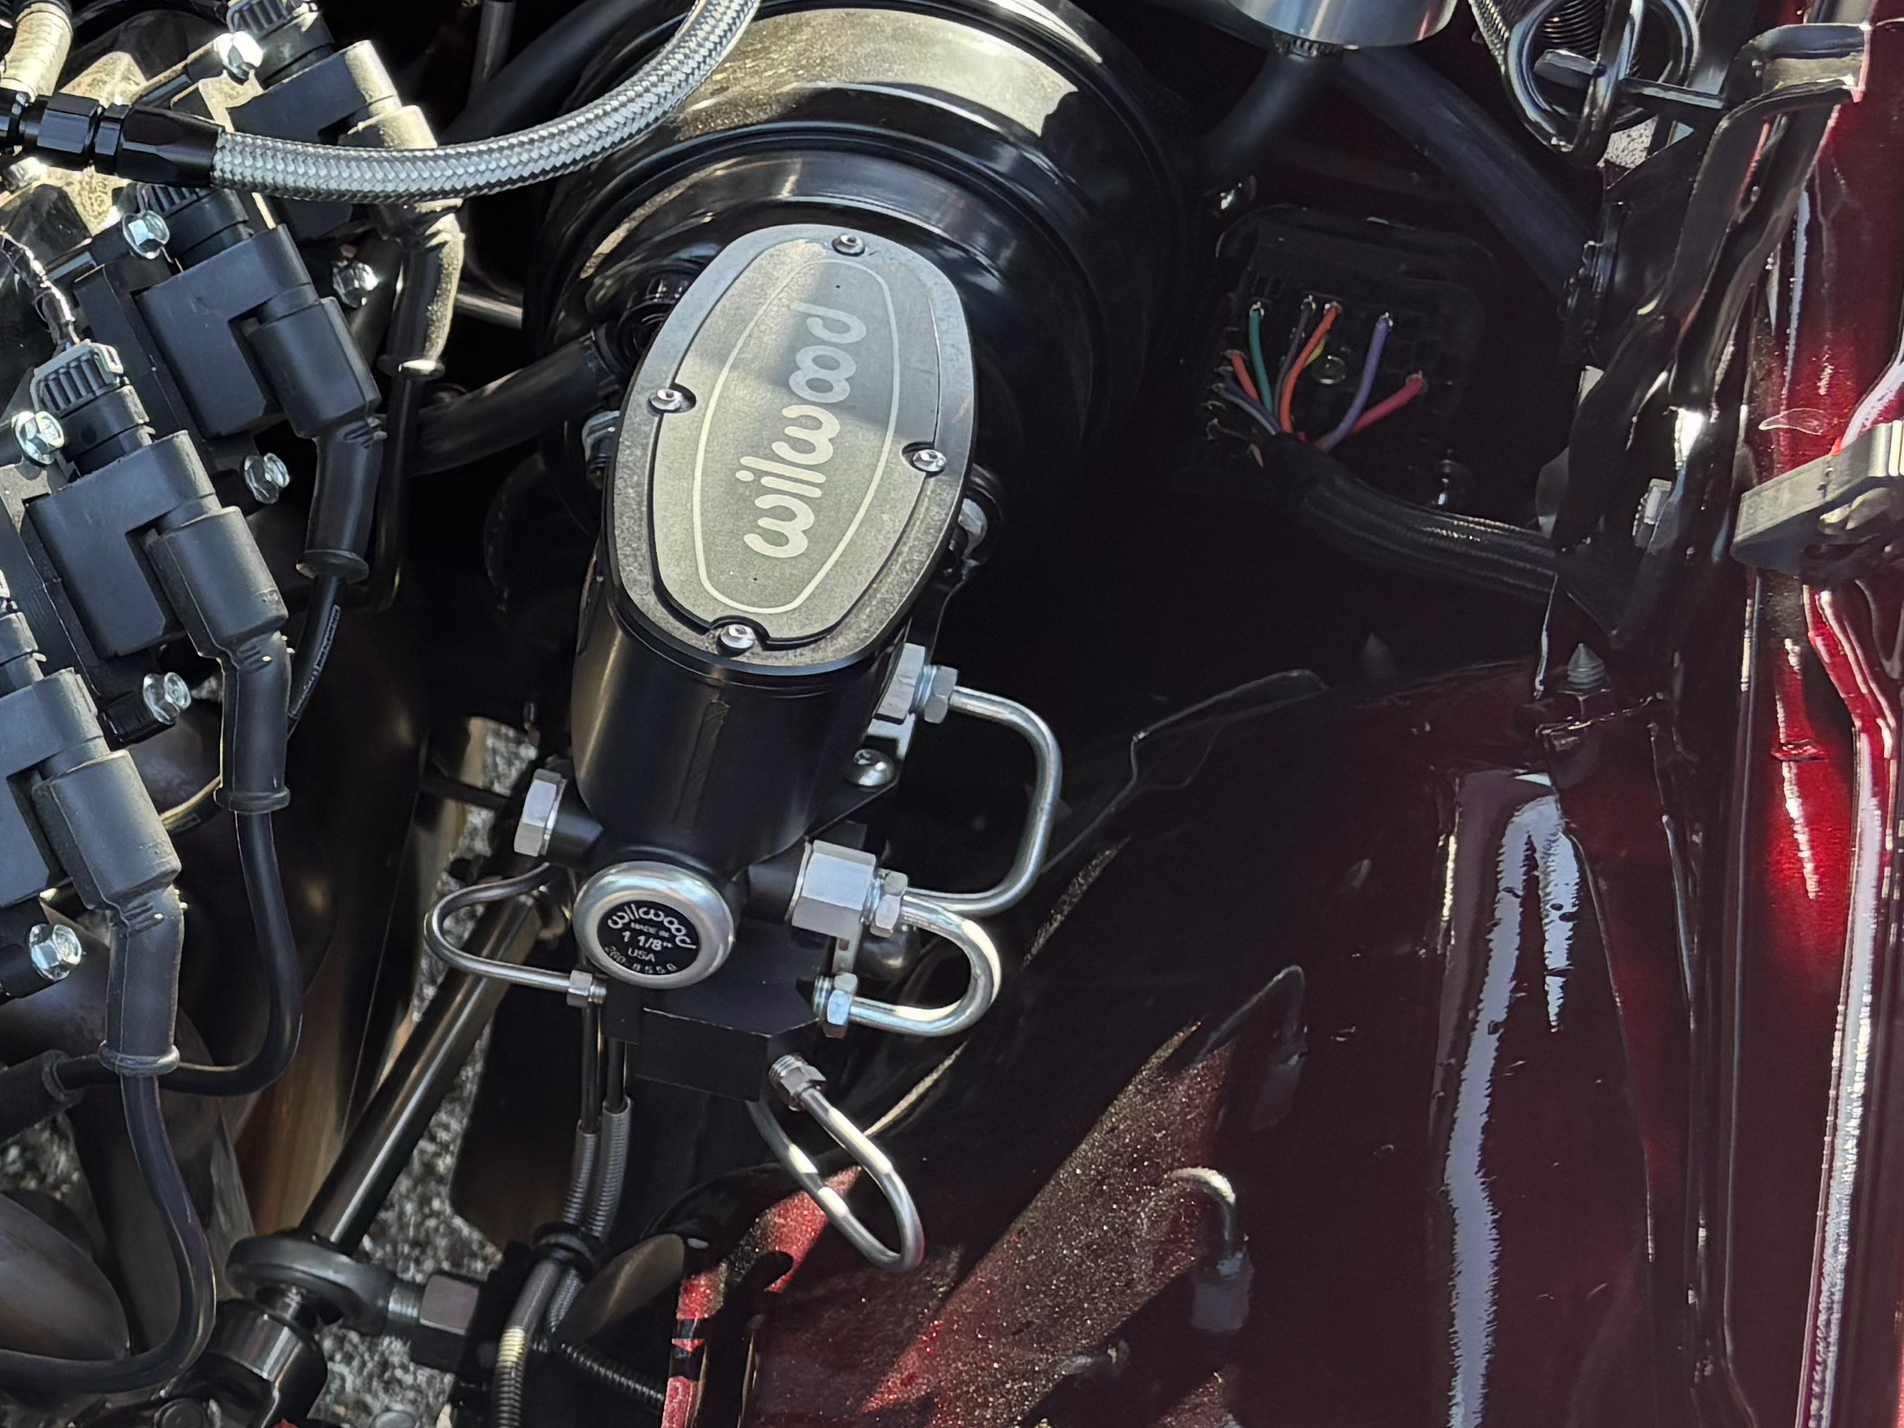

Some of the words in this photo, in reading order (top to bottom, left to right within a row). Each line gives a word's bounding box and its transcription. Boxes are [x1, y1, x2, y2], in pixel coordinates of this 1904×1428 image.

[735, 300, 867, 558] wilwood
[607, 903, 697, 950] wilwood
[622, 930, 631, 942] 1
[627, 947, 656, 963] USA
